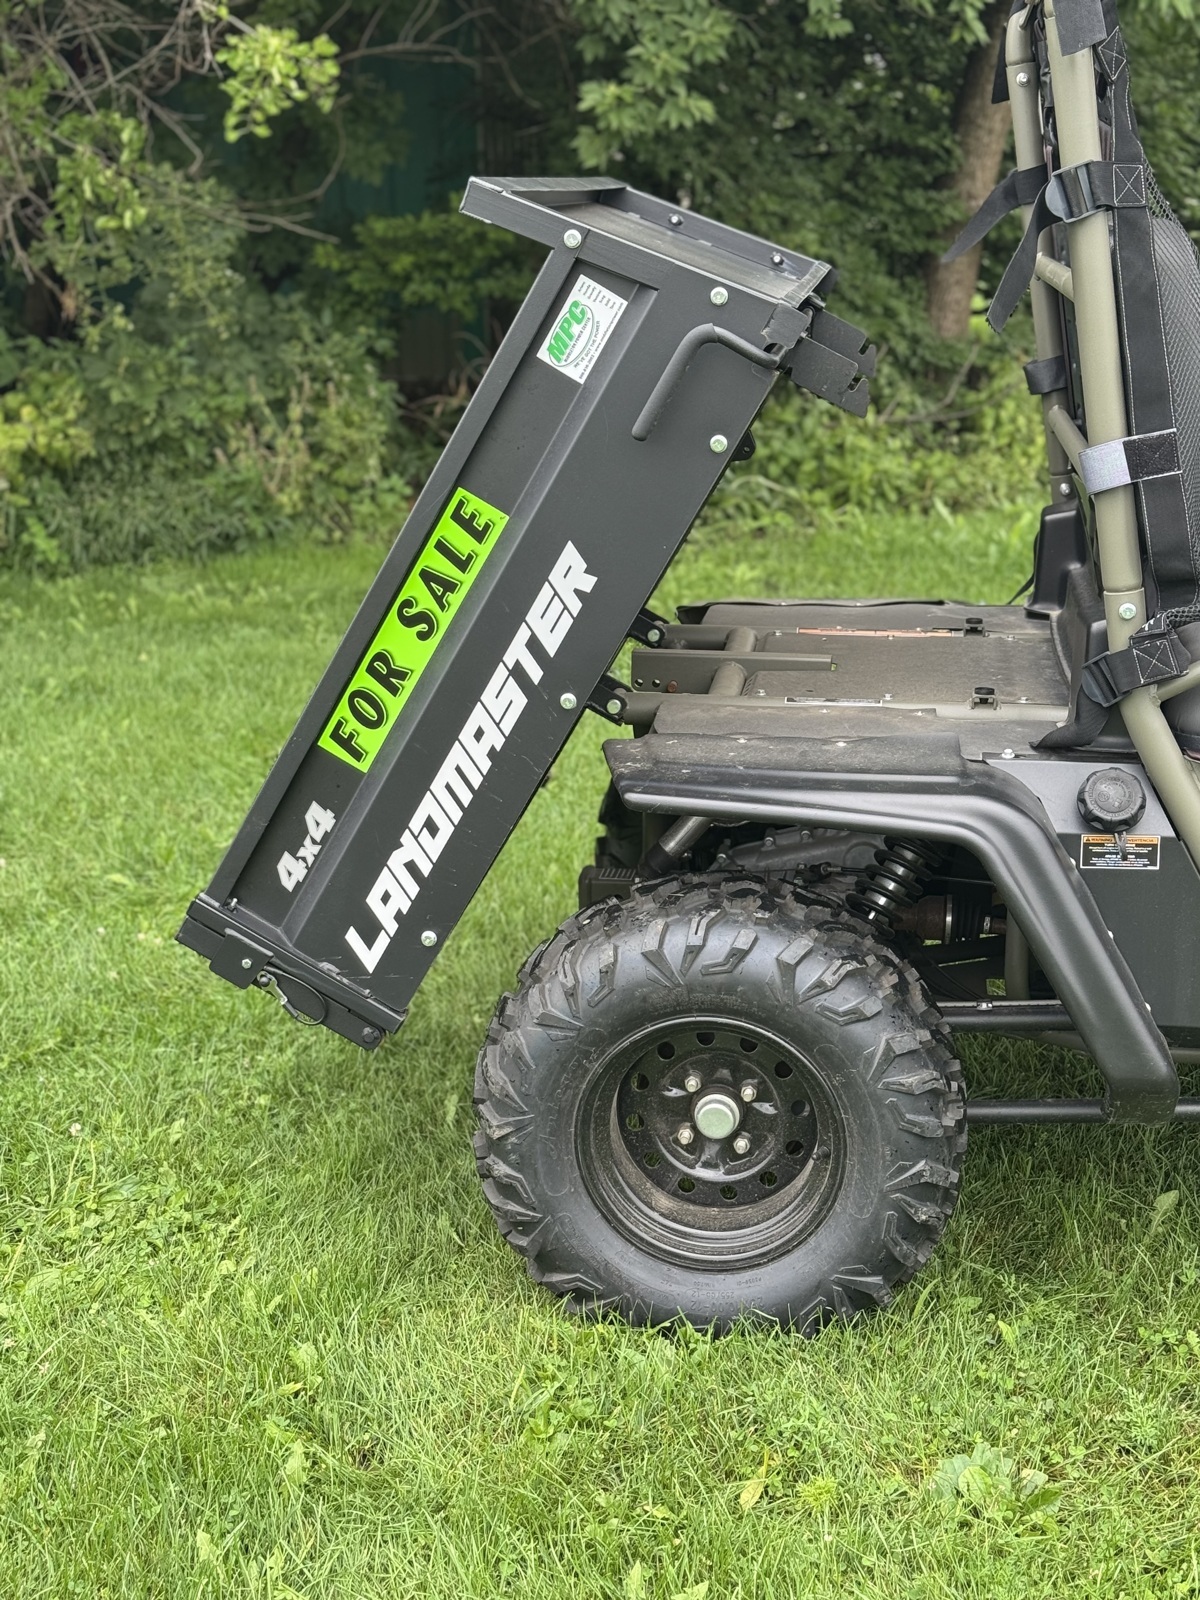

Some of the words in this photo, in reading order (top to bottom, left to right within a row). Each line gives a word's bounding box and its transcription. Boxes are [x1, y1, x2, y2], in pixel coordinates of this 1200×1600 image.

[547, 300, 586, 364] MPC
[329, 649, 413, 763] FOR
[397, 496, 494, 642] SALE
[277, 800, 336, 892] 4x4
[345, 540, 598, 974] LANDMASTER
